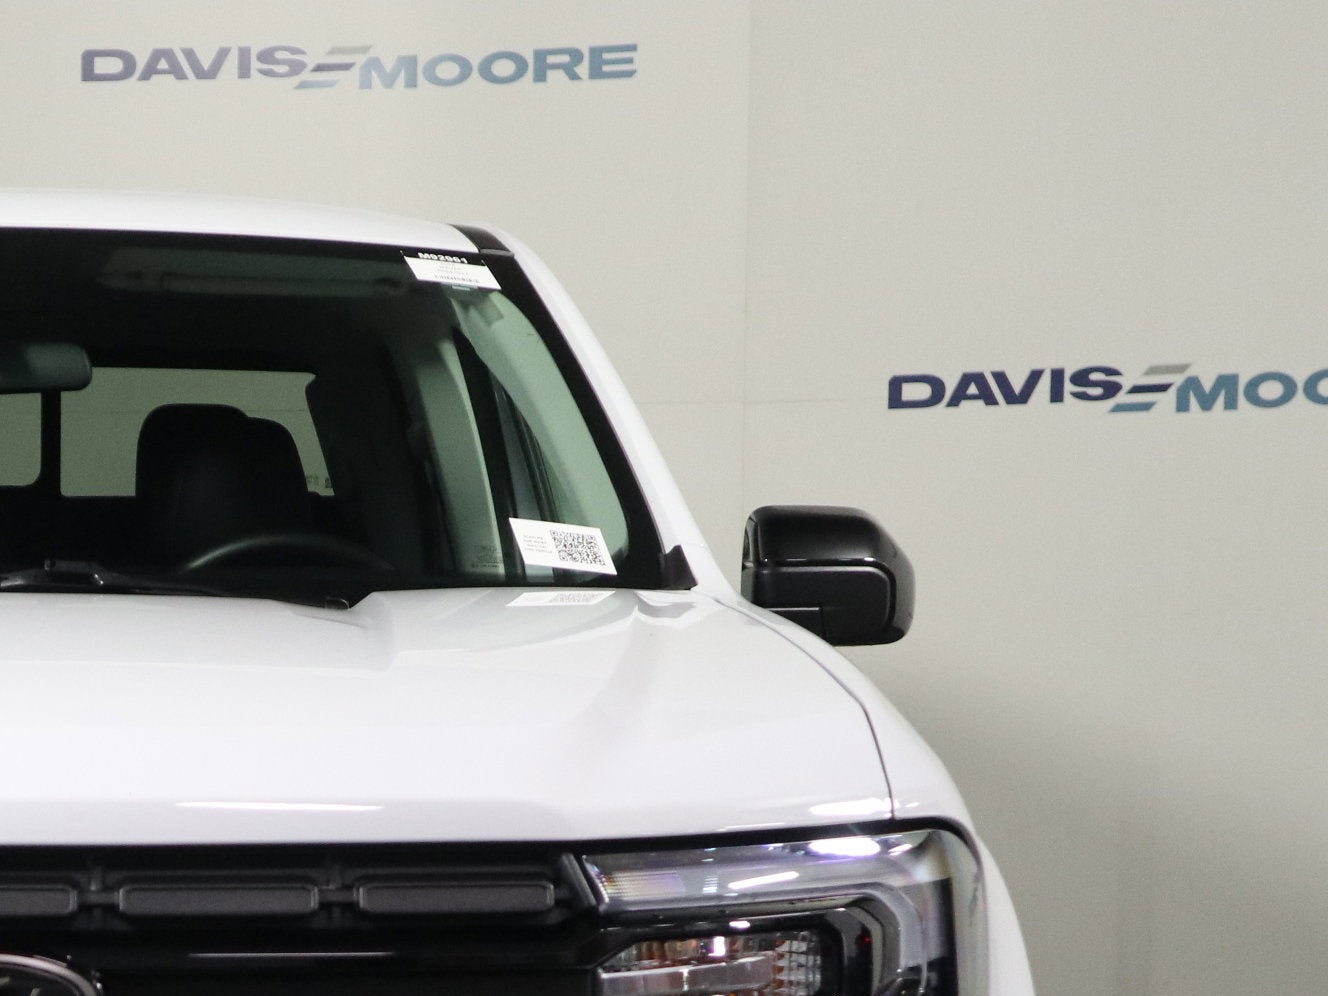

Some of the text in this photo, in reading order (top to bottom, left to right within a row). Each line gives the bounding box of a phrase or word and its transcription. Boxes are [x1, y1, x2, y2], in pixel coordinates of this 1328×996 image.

[81, 43, 638, 89] DAVIS MOORE
[887, 366, 1123, 409] DAVIS
